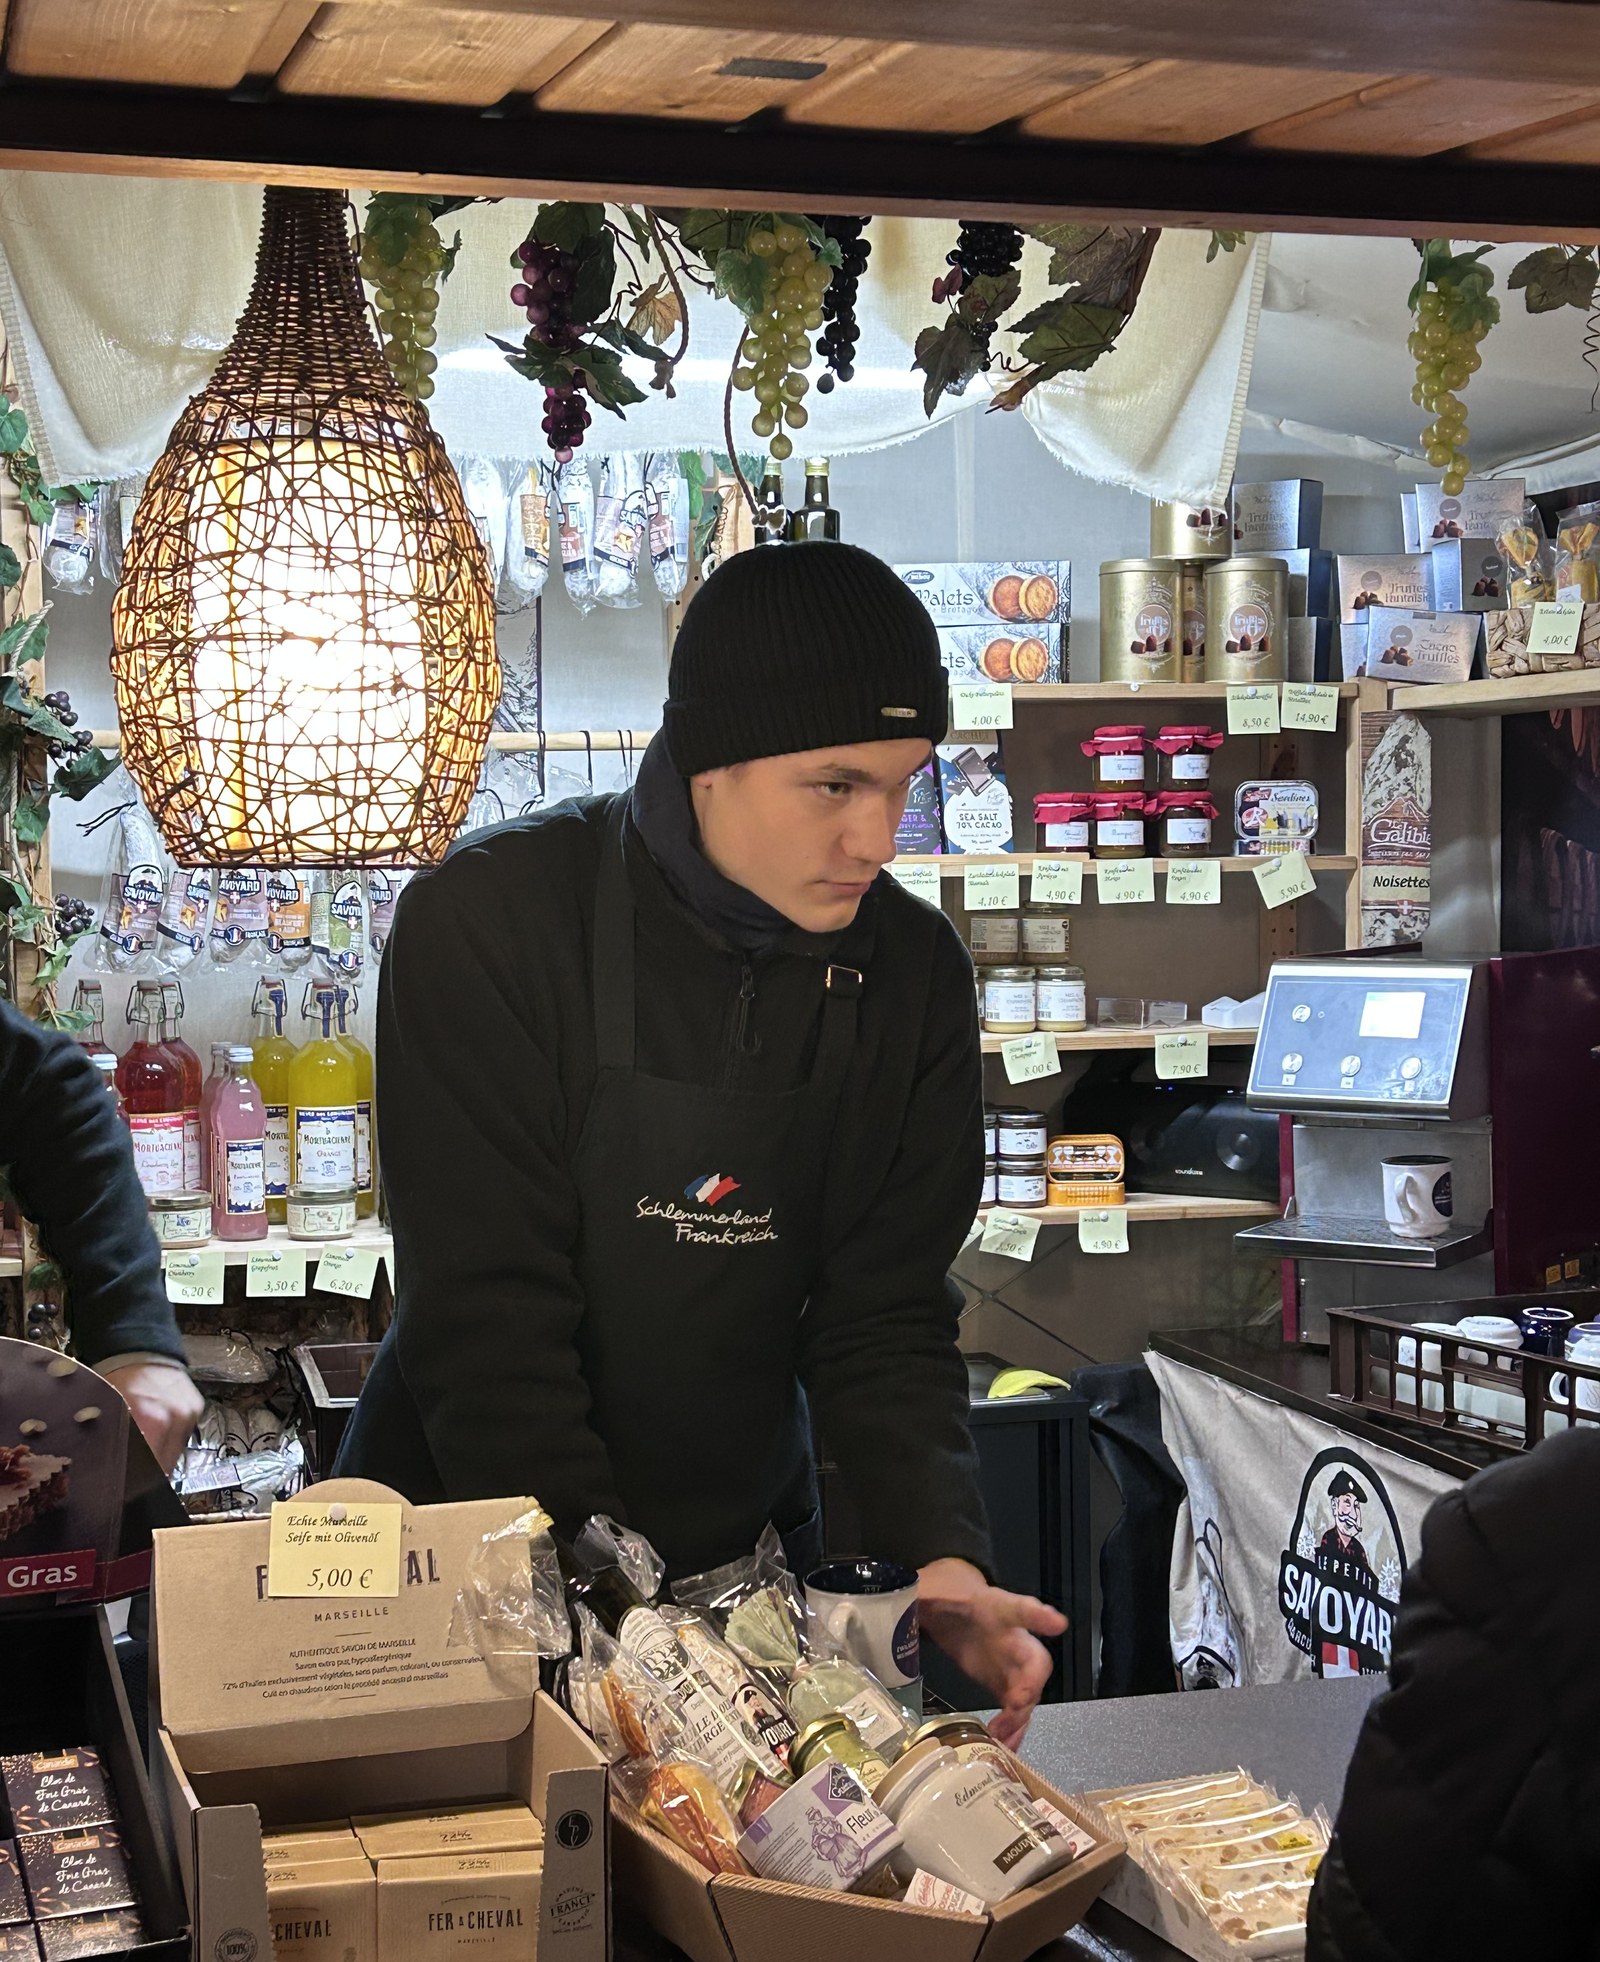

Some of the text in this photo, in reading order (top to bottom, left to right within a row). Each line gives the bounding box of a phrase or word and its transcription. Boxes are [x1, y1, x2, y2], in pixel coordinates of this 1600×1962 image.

[1263, 718, 1271, 728] €
[1321, 714, 1329, 725] €
[959, 812, 998, 821] SEA SALT
[956, 821, 1002, 829] 70% CACAO
[219, 880, 260, 892] AVOYARD
[1300, 880, 1308, 892] €
[1372, 874, 1431, 888] Noisettes
[266, 889, 299, 901] VOYARD
[1000, 895, 1009, 906] €
[1067, 891, 1076, 901] €
[1137, 889, 1144, 899] €
[1203, 891, 1211, 901] €
[1193, 1063, 1201, 1074] €
[636, 1196, 773, 1226] Schlemmerland
[675, 1222, 778, 1245] Frankreich
[1114, 1239, 1122, 1250] €
[181, 1286, 215, 1298] 6,20 €
[264, 1280, 299, 1292] 3,50 €
[329, 1279, 363, 1293] 6,20 €
[287, 1515, 369, 1527] Echte Marseille
[285, 1532, 380, 1545] Seife mit Olivenöl
[7, 1565, 78, 1588] Gras
[307, 1568, 373, 1590] 5,00 €
[1318, 1555, 1372, 1590] LE PETIT
[314, 1606, 389, 1622] MARSEILLE
[1283, 1563, 1397, 1666] SAVOYAR
[341, 1643, 366, 1653] SAVON
[367, 1641, 377, 1651] DE
[295, 1661, 317, 1671] Savon
[318, 1659, 336, 1668] extra
[222, 1682, 238, 1691] 72%
[268, 1673, 318, 1686] exclusivement
[431, 1660, 441, 1668] ou
[278, 1689, 288, 1697] en
[289, 1685, 323, 1696] chaudron
[324, 1682, 343, 1692] selon
[344, 1682, 351, 1690] le
[41, 1772, 76, 1788] Bloc de
[35, 1785, 89, 1801] Foie Gras
[955, 1779, 994, 1806] Edmond
[38, 1797, 92, 1814] de Canard
[846, 1808, 874, 1835] Fleur
[61, 1853, 97, 1869] Bloc de
[56, 1867, 110, 1883] Foie Gras
[59, 1877, 113, 1895] de Canard
[428, 1912, 454, 1932] FER
[468, 1908, 523, 1930] CHEVAL
[275, 1919, 332, 1942] CHEVAL
